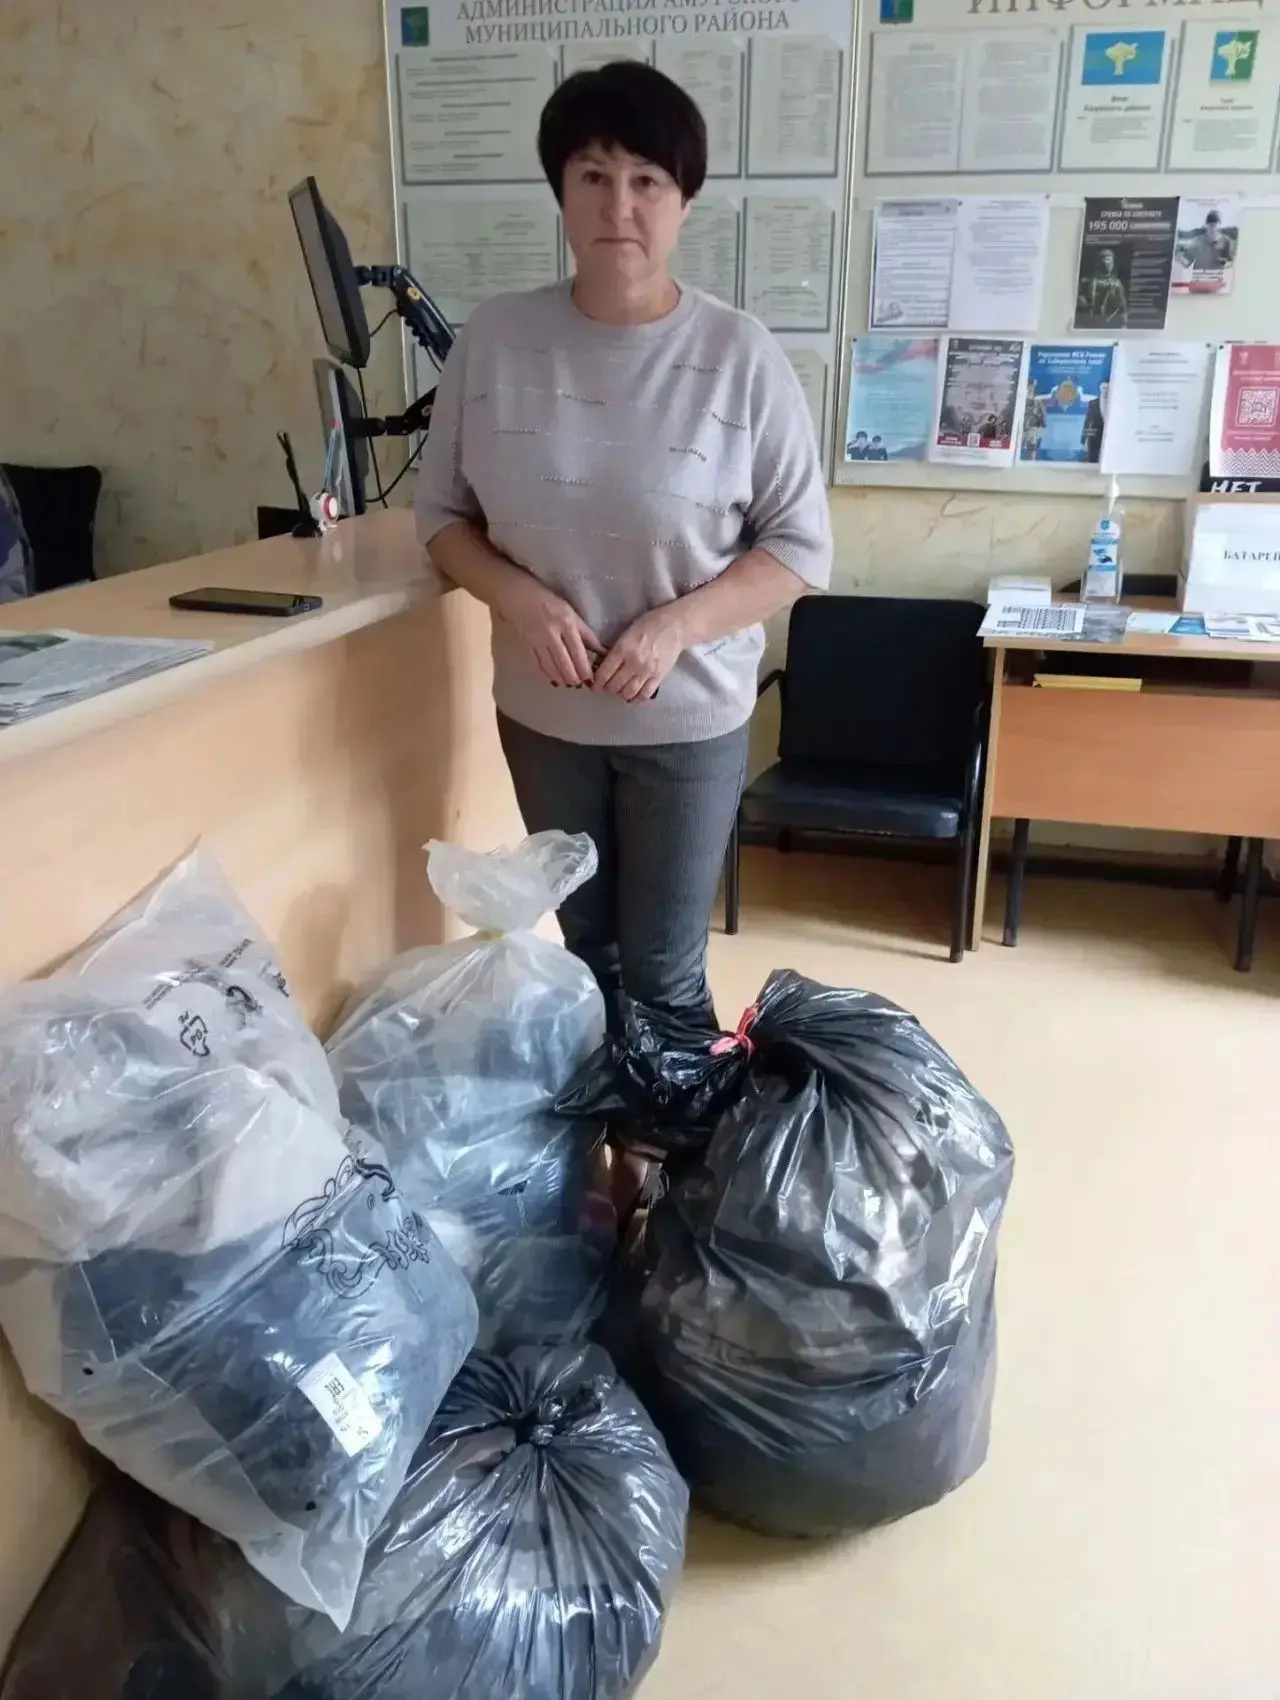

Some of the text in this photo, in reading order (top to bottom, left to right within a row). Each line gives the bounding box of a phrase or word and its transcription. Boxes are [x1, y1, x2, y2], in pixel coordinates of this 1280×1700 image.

[465, 8, 790, 44] МУНИЦИПАЛЬНОГО РАЙОНА
[1089, 222, 1106, 231] 195
[1108, 221, 1128, 230] 000
